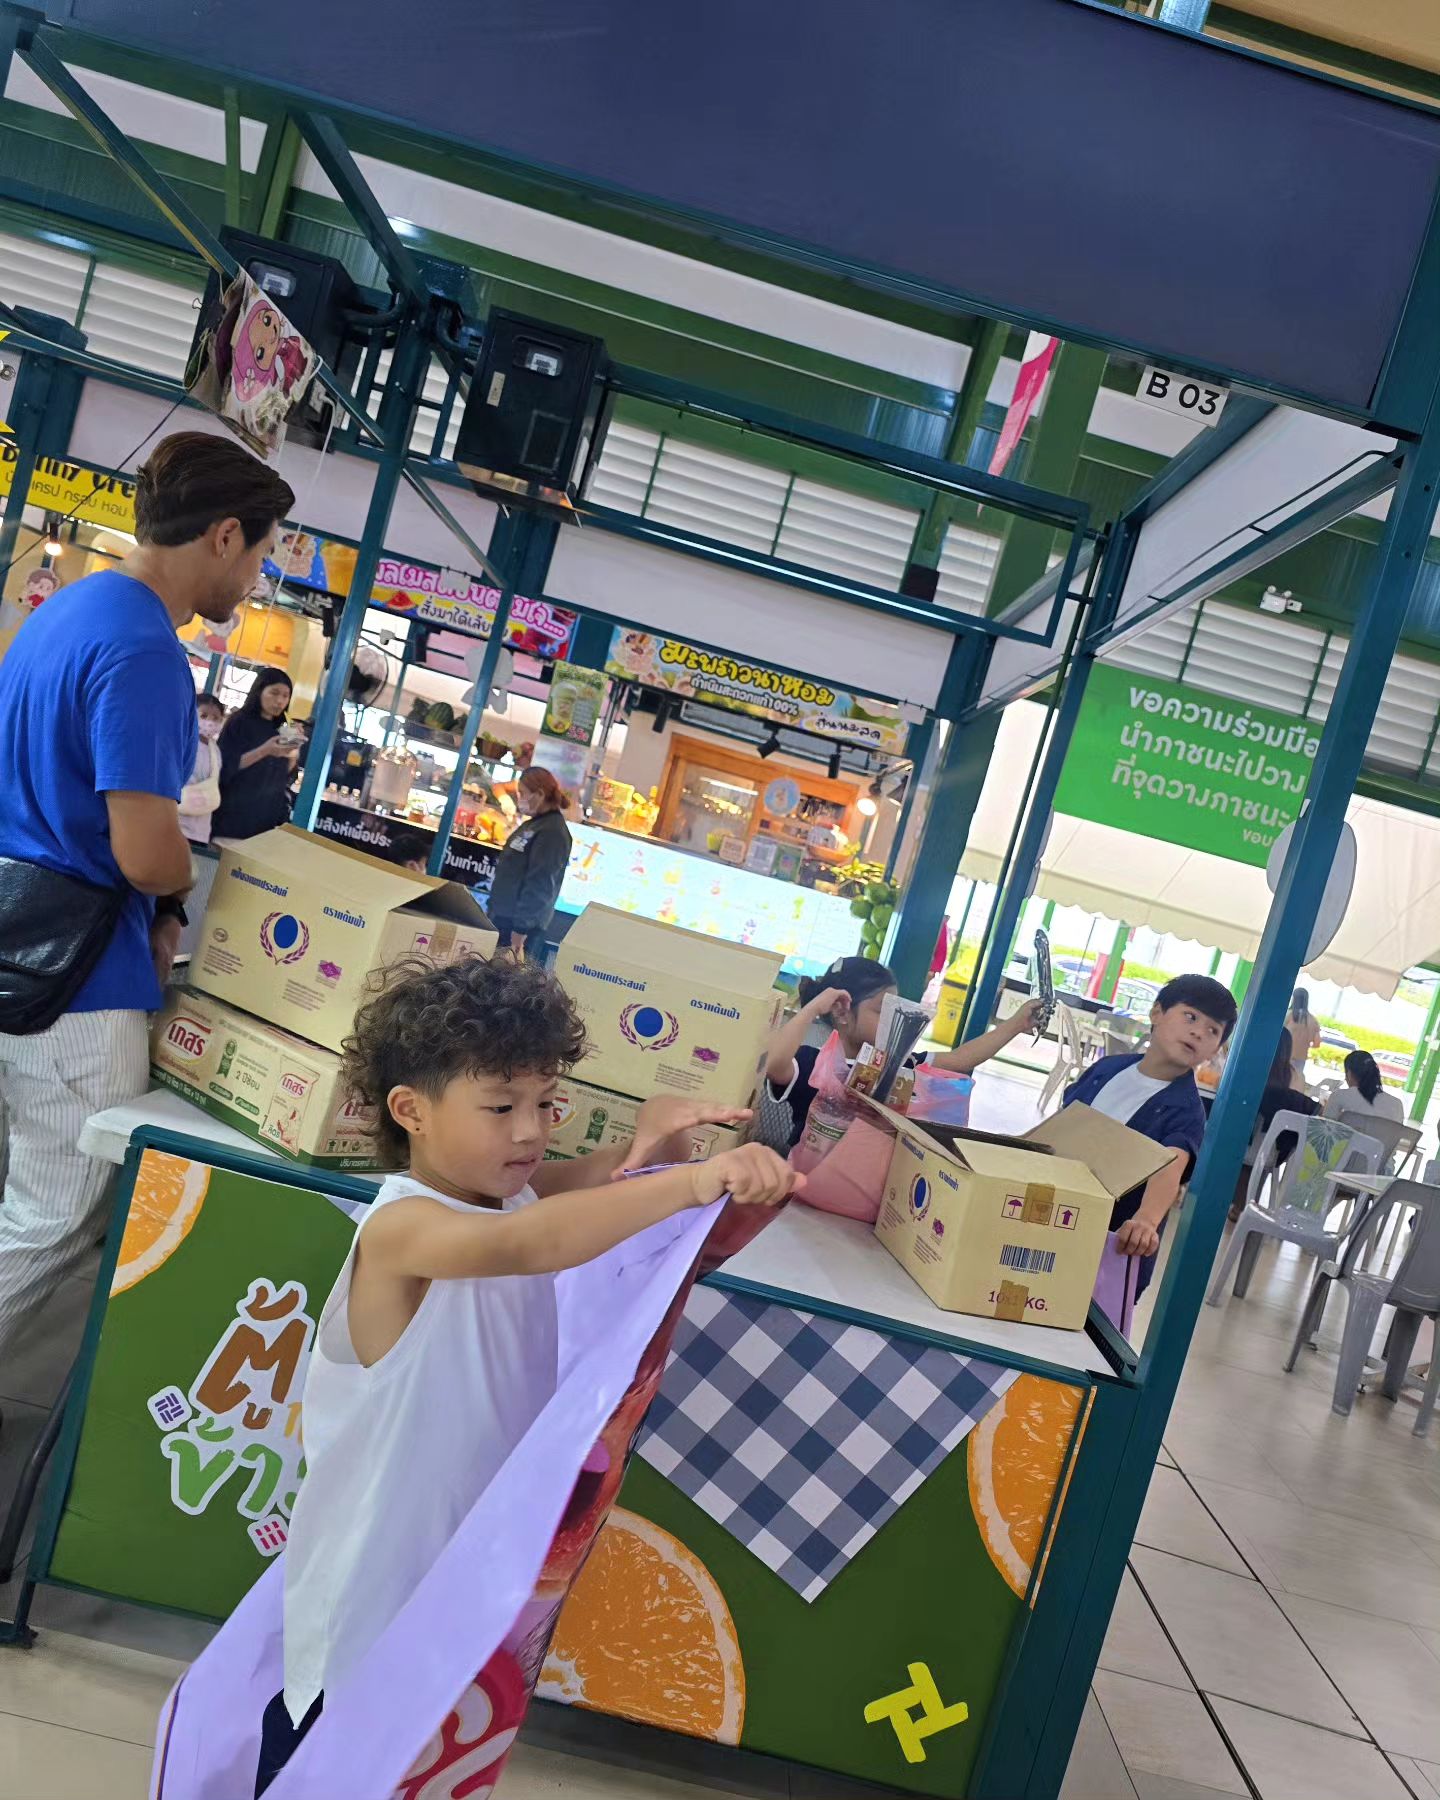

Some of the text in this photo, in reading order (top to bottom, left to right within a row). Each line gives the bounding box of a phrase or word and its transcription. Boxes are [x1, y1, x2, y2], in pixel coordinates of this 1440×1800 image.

[1146, 371, 1220, 415] B 03
[2, 444, 81, 481] Bnny
[1128, 686, 1321, 758] ขอความร่วมมือ
[1119, 720, 1307, 794] นำภาชนะไปวาง
[1111, 753, 1291, 829] ที่จุดวางภาชนะ
[1242, 829, 1277, 849] ขอบ
[1024, 1296, 1048, 1312] KG.
[168, 1416, 308, 1516] ข้า
